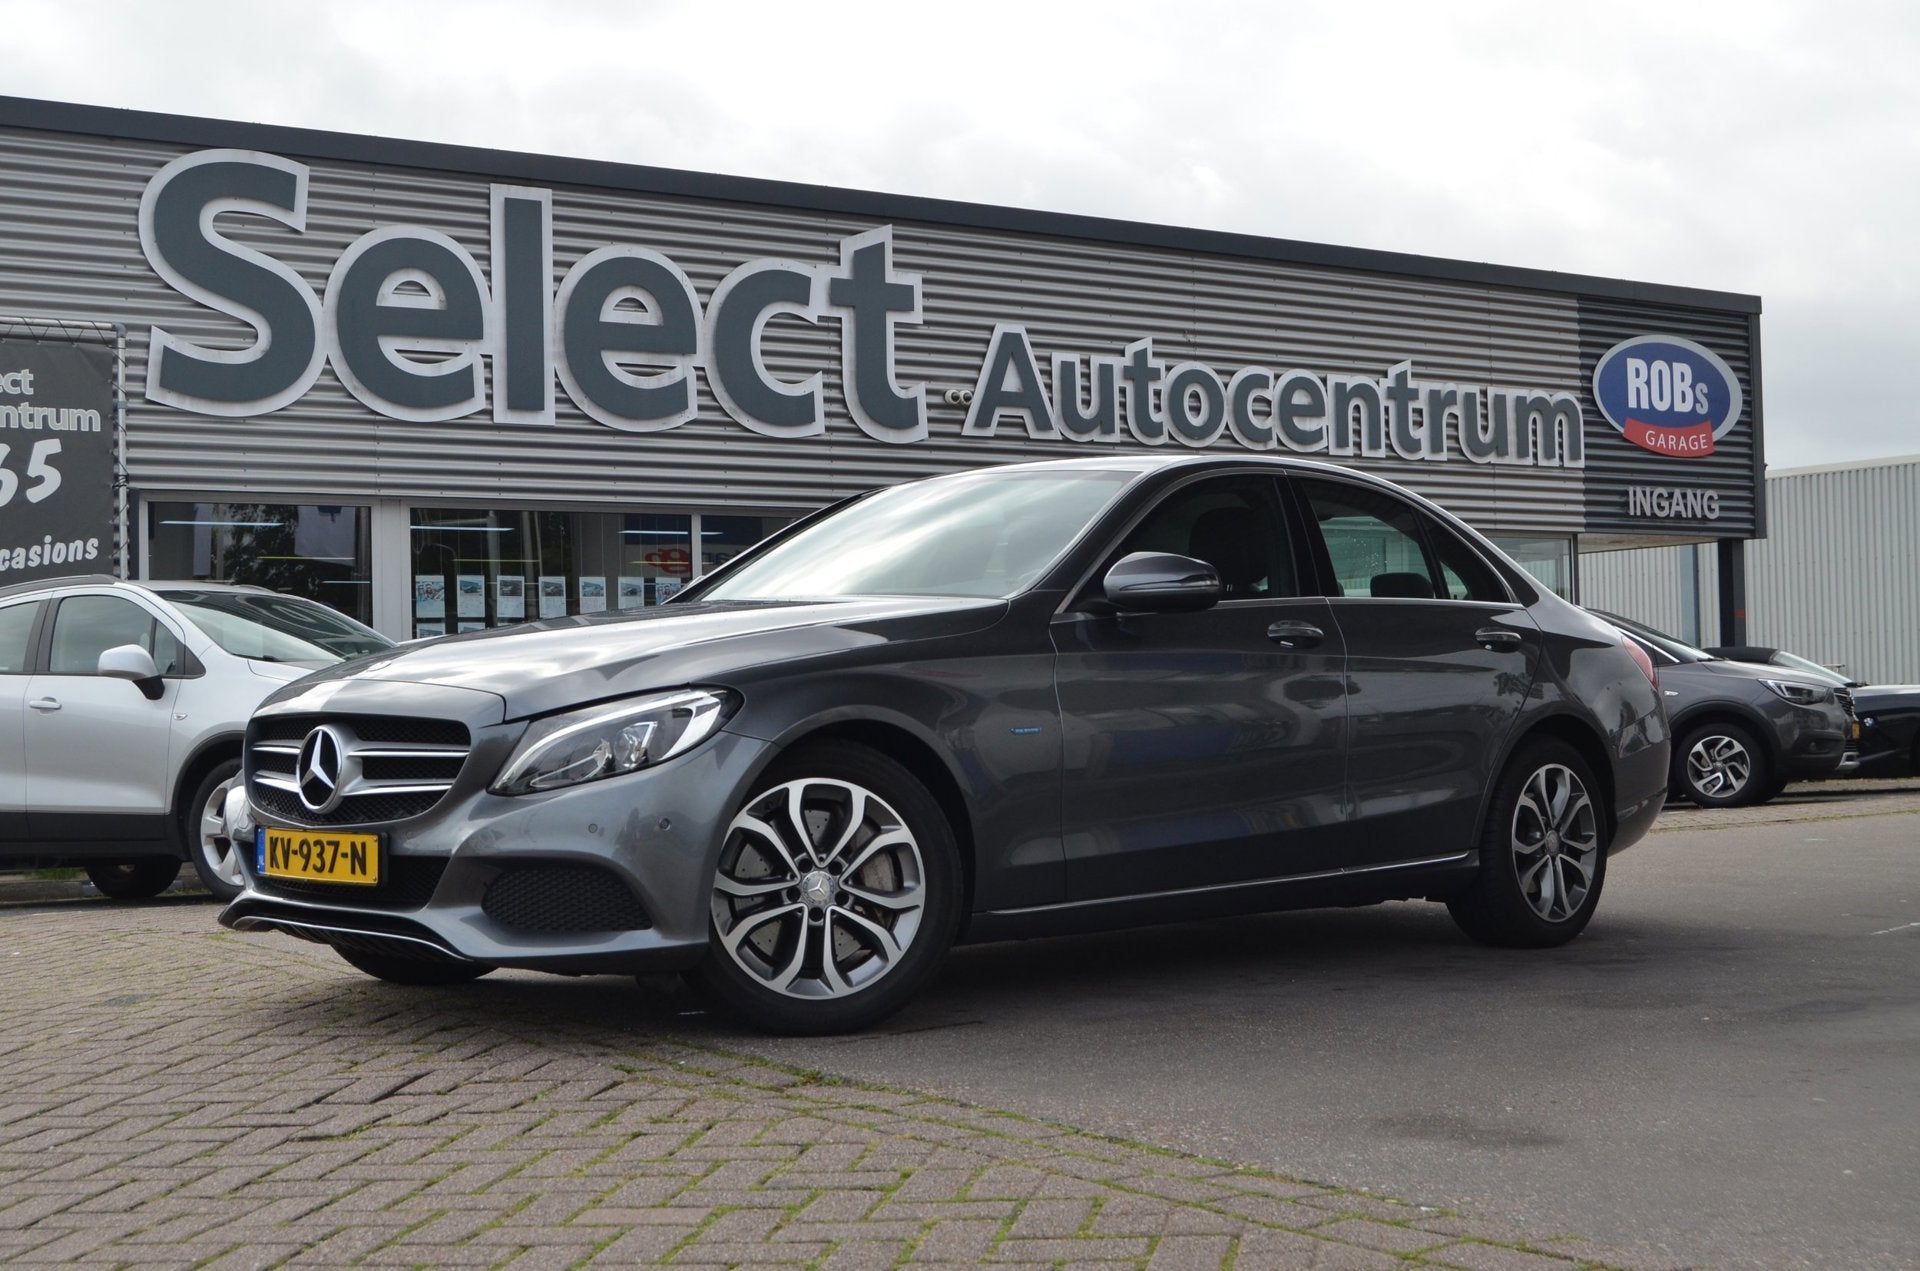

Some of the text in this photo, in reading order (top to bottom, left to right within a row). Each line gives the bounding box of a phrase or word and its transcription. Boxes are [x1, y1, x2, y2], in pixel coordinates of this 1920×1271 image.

[138, 147, 1586, 468] Select Autocentrum
[1627, 358, 1708, 415] ROBs
[1645, 430, 1708, 450] GARAGE
[1628, 486, 1720, 519] INGANG
[269, 836, 367, 876] KV-937-N
